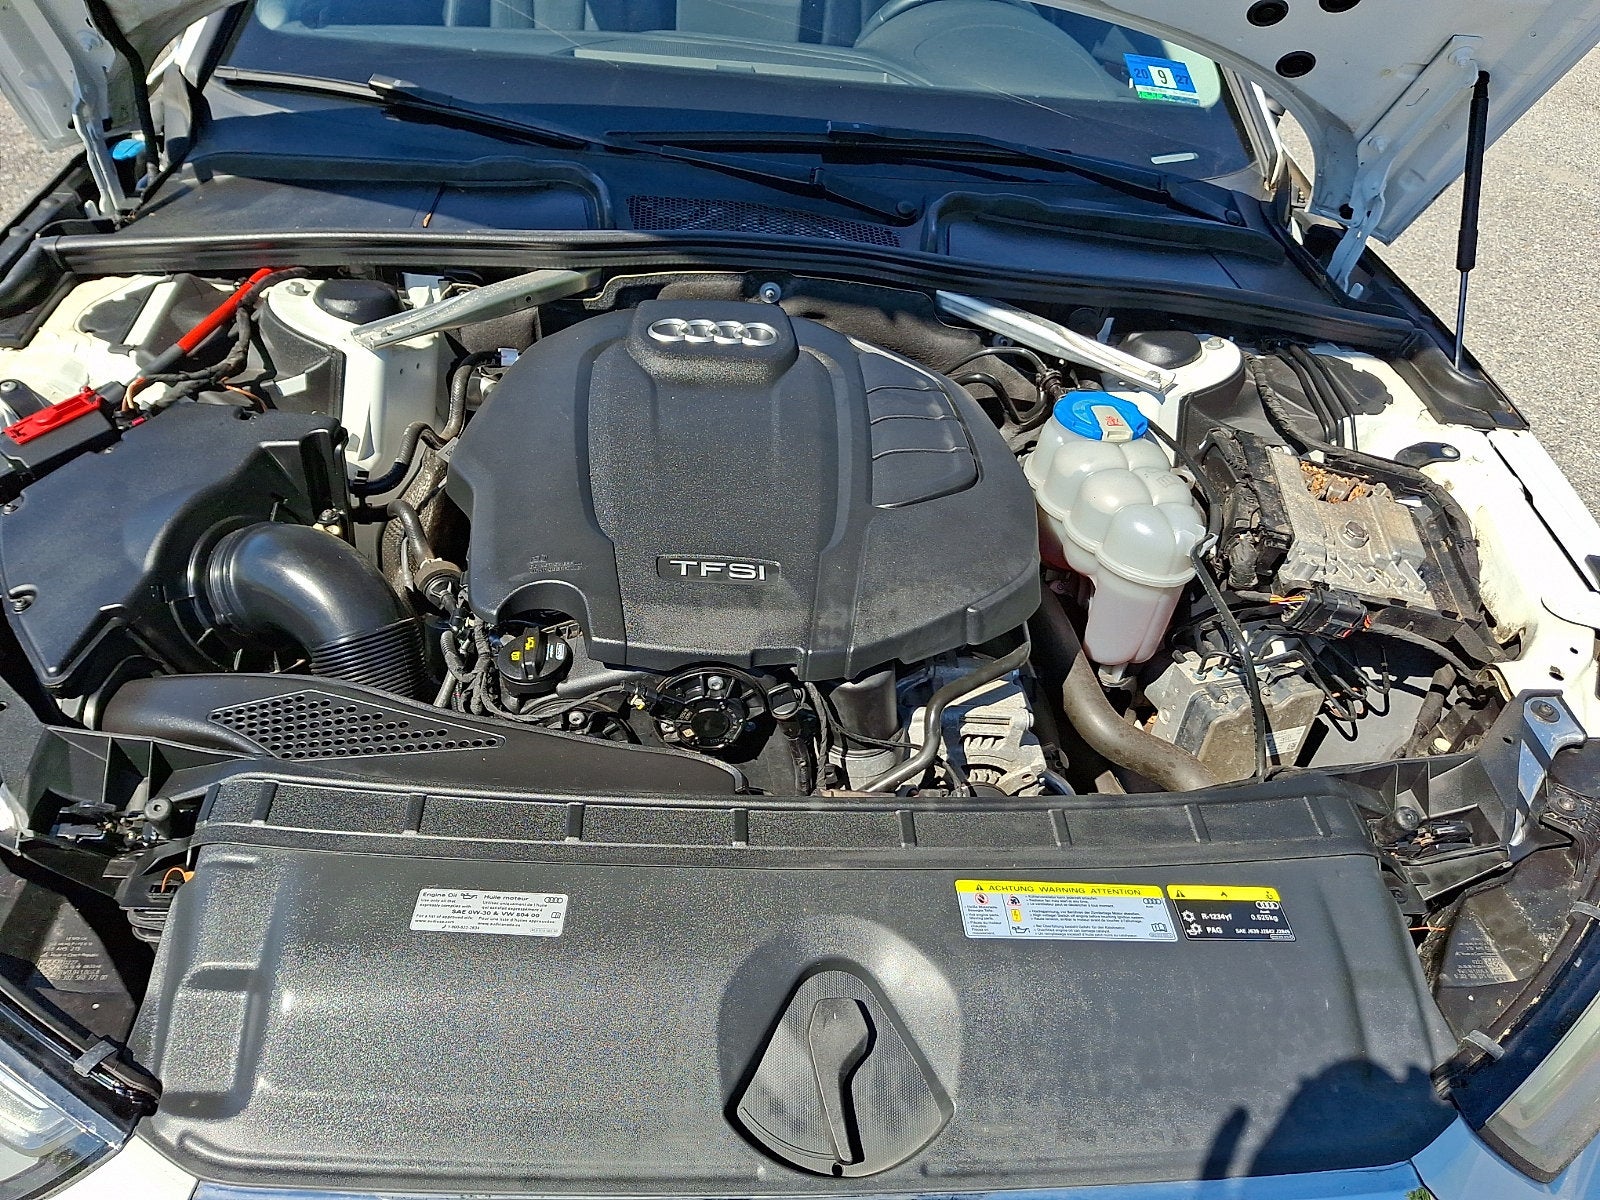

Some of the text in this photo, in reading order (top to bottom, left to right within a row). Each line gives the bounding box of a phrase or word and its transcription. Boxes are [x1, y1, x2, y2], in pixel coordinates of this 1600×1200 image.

[1134, 68, 1189, 85] 20 9 27
[669, 560, 766, 581] TFSI
[988, 885, 1141, 896] ACHTUNG WARNING ATTENTION
[1206, 926, 1223, 934] PAG
